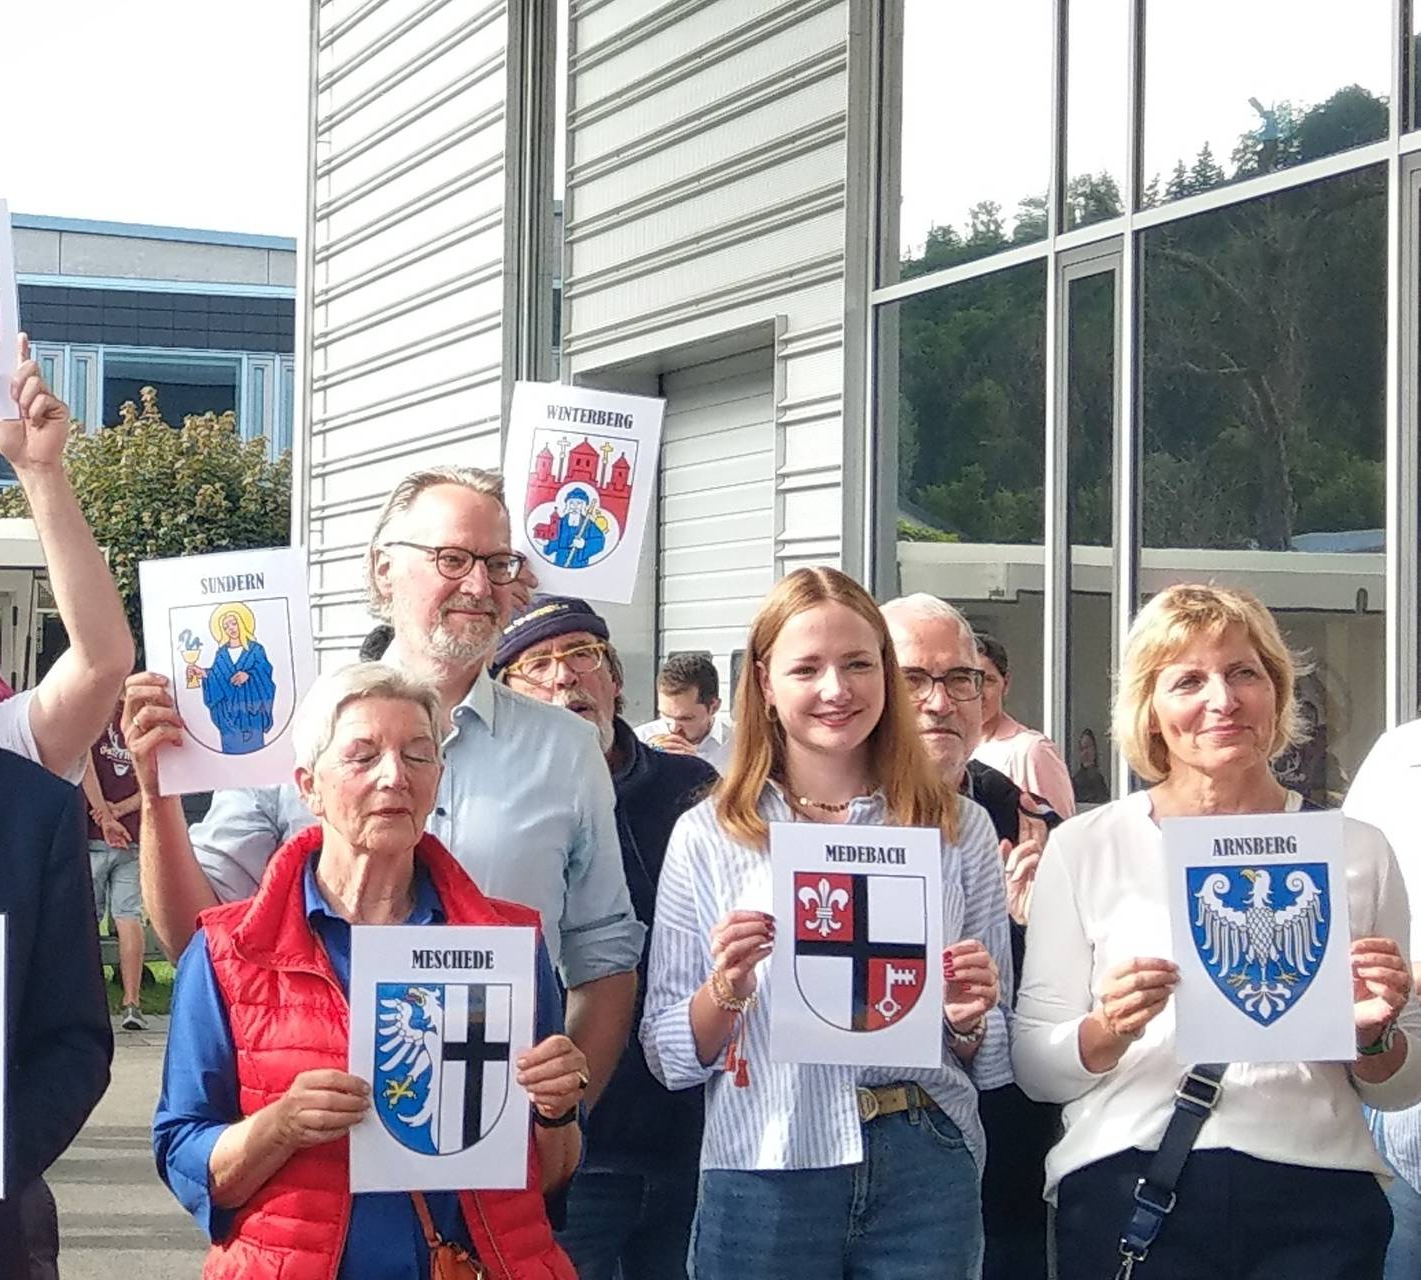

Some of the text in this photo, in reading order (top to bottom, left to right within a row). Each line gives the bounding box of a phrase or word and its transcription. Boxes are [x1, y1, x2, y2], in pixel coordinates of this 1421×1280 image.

[546, 404, 634, 430] WINTERBERG
[199, 572, 265, 595] SUNDERN
[825, 844, 907, 866] MEDEBACH
[1213, 835, 1298, 858] ARNSBERG
[411, 948, 495, 970] MESCHEDE
